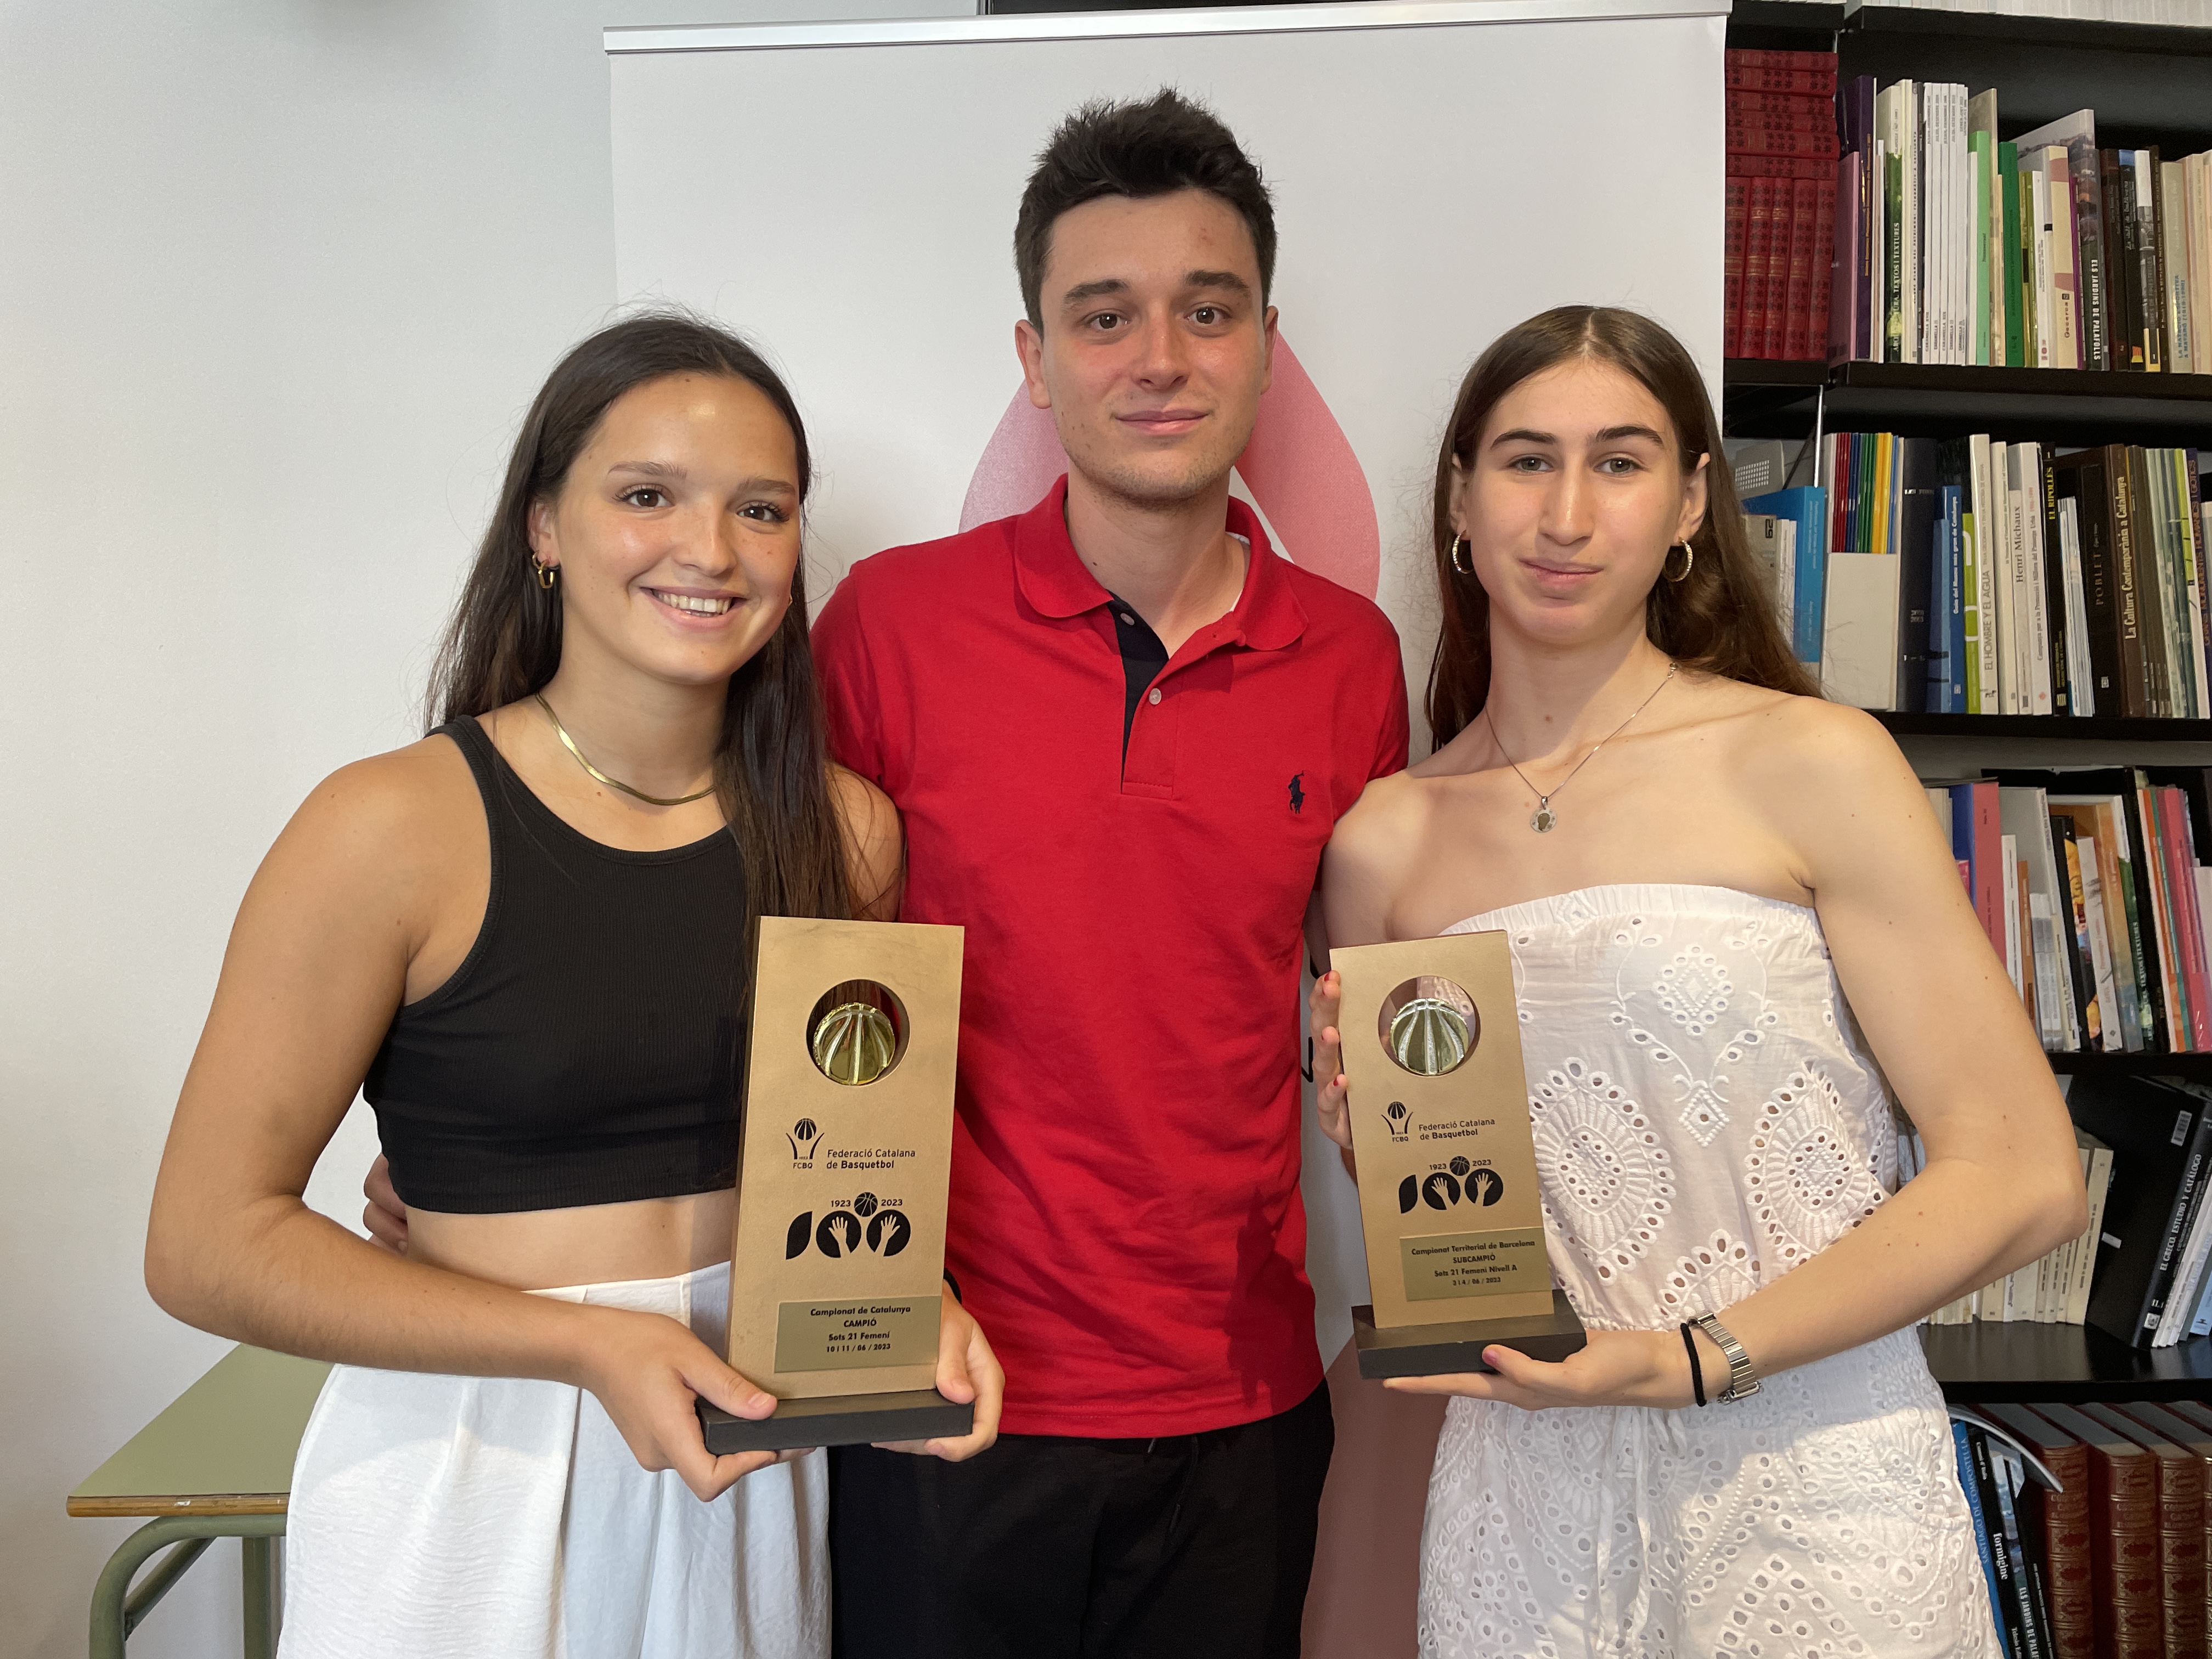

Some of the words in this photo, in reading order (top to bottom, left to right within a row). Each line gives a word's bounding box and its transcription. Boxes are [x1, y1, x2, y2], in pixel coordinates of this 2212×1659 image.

[2092, 308, 2099, 317] DE
[2178, 349, 2183, 358] LA
[2046, 467, 2055, 507] RIPOLLÈS
[2115, 477, 2128, 518] Catalunya
[2013, 506, 2022, 550] Michaux
[2118, 528, 2133, 591] Contemporània
[2015, 554, 2023, 583] Henri
[2093, 551, 2103, 605] POBLET
[1982, 570, 1990, 599] AGUA
[1983, 601, 1991, 610] EL
[2124, 592, 2136, 625] Cultura
[2125, 627, 2136, 639] La
[1983, 621, 1992, 659] HOMBRE
[1984, 662, 1993, 670] EL
[1419, 1121, 1457, 1131] Federació
[1460, 1119, 1496, 1128] Catalana
[1432, 1129, 1478, 1139] Basquetbol
[827, 1148, 873, 1158] Federació
[875, 1149, 916, 1158] Catalana
[841, 1160, 894, 1170] Basquetbol
[2171, 1202, 2187, 1233] ESTUDIO
[2184, 1154, 2202, 1193] CATÁLOGO
[1412, 1246, 1449, 1255] Campionat
[1452, 1243, 1486, 1252] Territorial
[1499, 1240, 1535, 1248] Barcelona
[1453, 1252, 1496, 1263] SUBCAMPIÓ
[1462, 1266, 1487, 1275] Femení
[810, 1307, 856, 1317] Campionat
[871, 1305, 911, 1314] Catalunya
[844, 1317, 877, 1328] CAMPIÓ
[828, 1333, 845, 1341] Sots
[860, 1330, 890, 1340] Femení
[1976, 1519, 1989, 1565] SANTIAGO
[1993, 1533, 2008, 1580] formigine
[2019, 1587, 2028, 1599] ELS
[2022, 1601, 2033, 1627] JARDINS
[2027, 1628, 2035, 1638] DE
